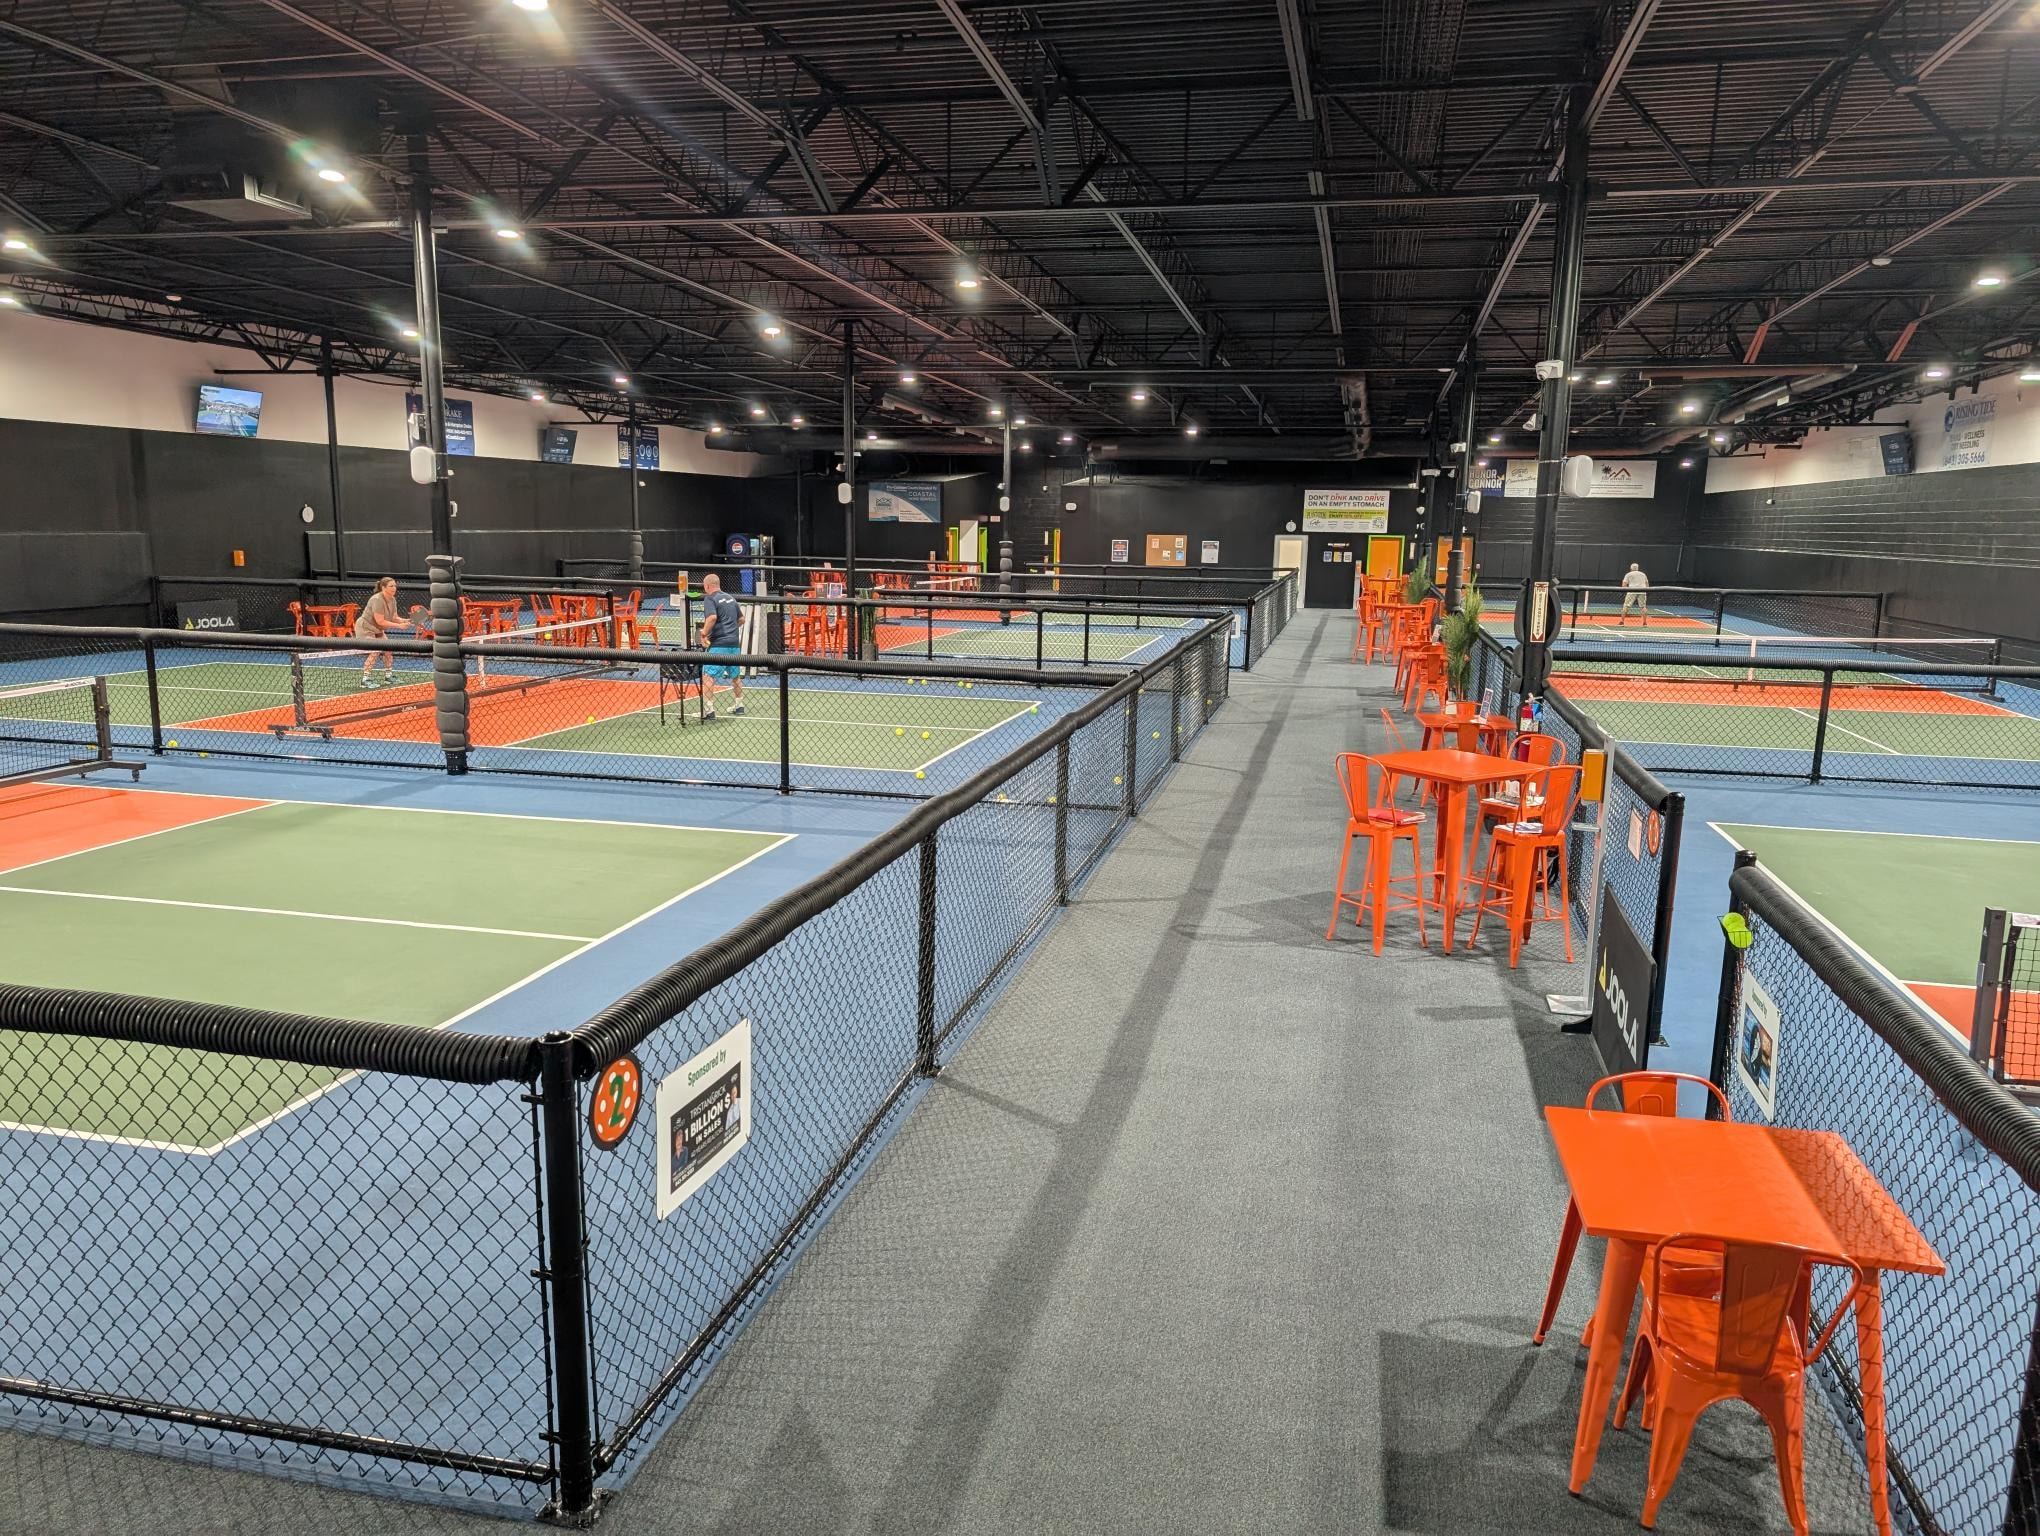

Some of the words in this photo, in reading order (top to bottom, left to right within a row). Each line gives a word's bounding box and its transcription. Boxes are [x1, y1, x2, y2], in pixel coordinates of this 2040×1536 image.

[1956, 403, 1979, 419] RISING
[1979, 400, 1997, 415] TIDE
[1469, 479, 1502, 489] CONNOR
[1470, 469, 1497, 479] HONOR
[195, 616, 235, 629] JOOLA
[1605, 967, 1638, 1064] JOOLA
[687, 1053, 719, 1087] Sponsored
[719, 1048, 727, 1064] by
[609, 1075, 625, 1128] 2
[684, 1127, 689, 1142] 1
[690, 1100, 724, 1138] BILLION
[724, 1092, 731, 1109] $
[695, 1132, 703, 1146] IN
[703, 1117, 722, 1138] SALES
